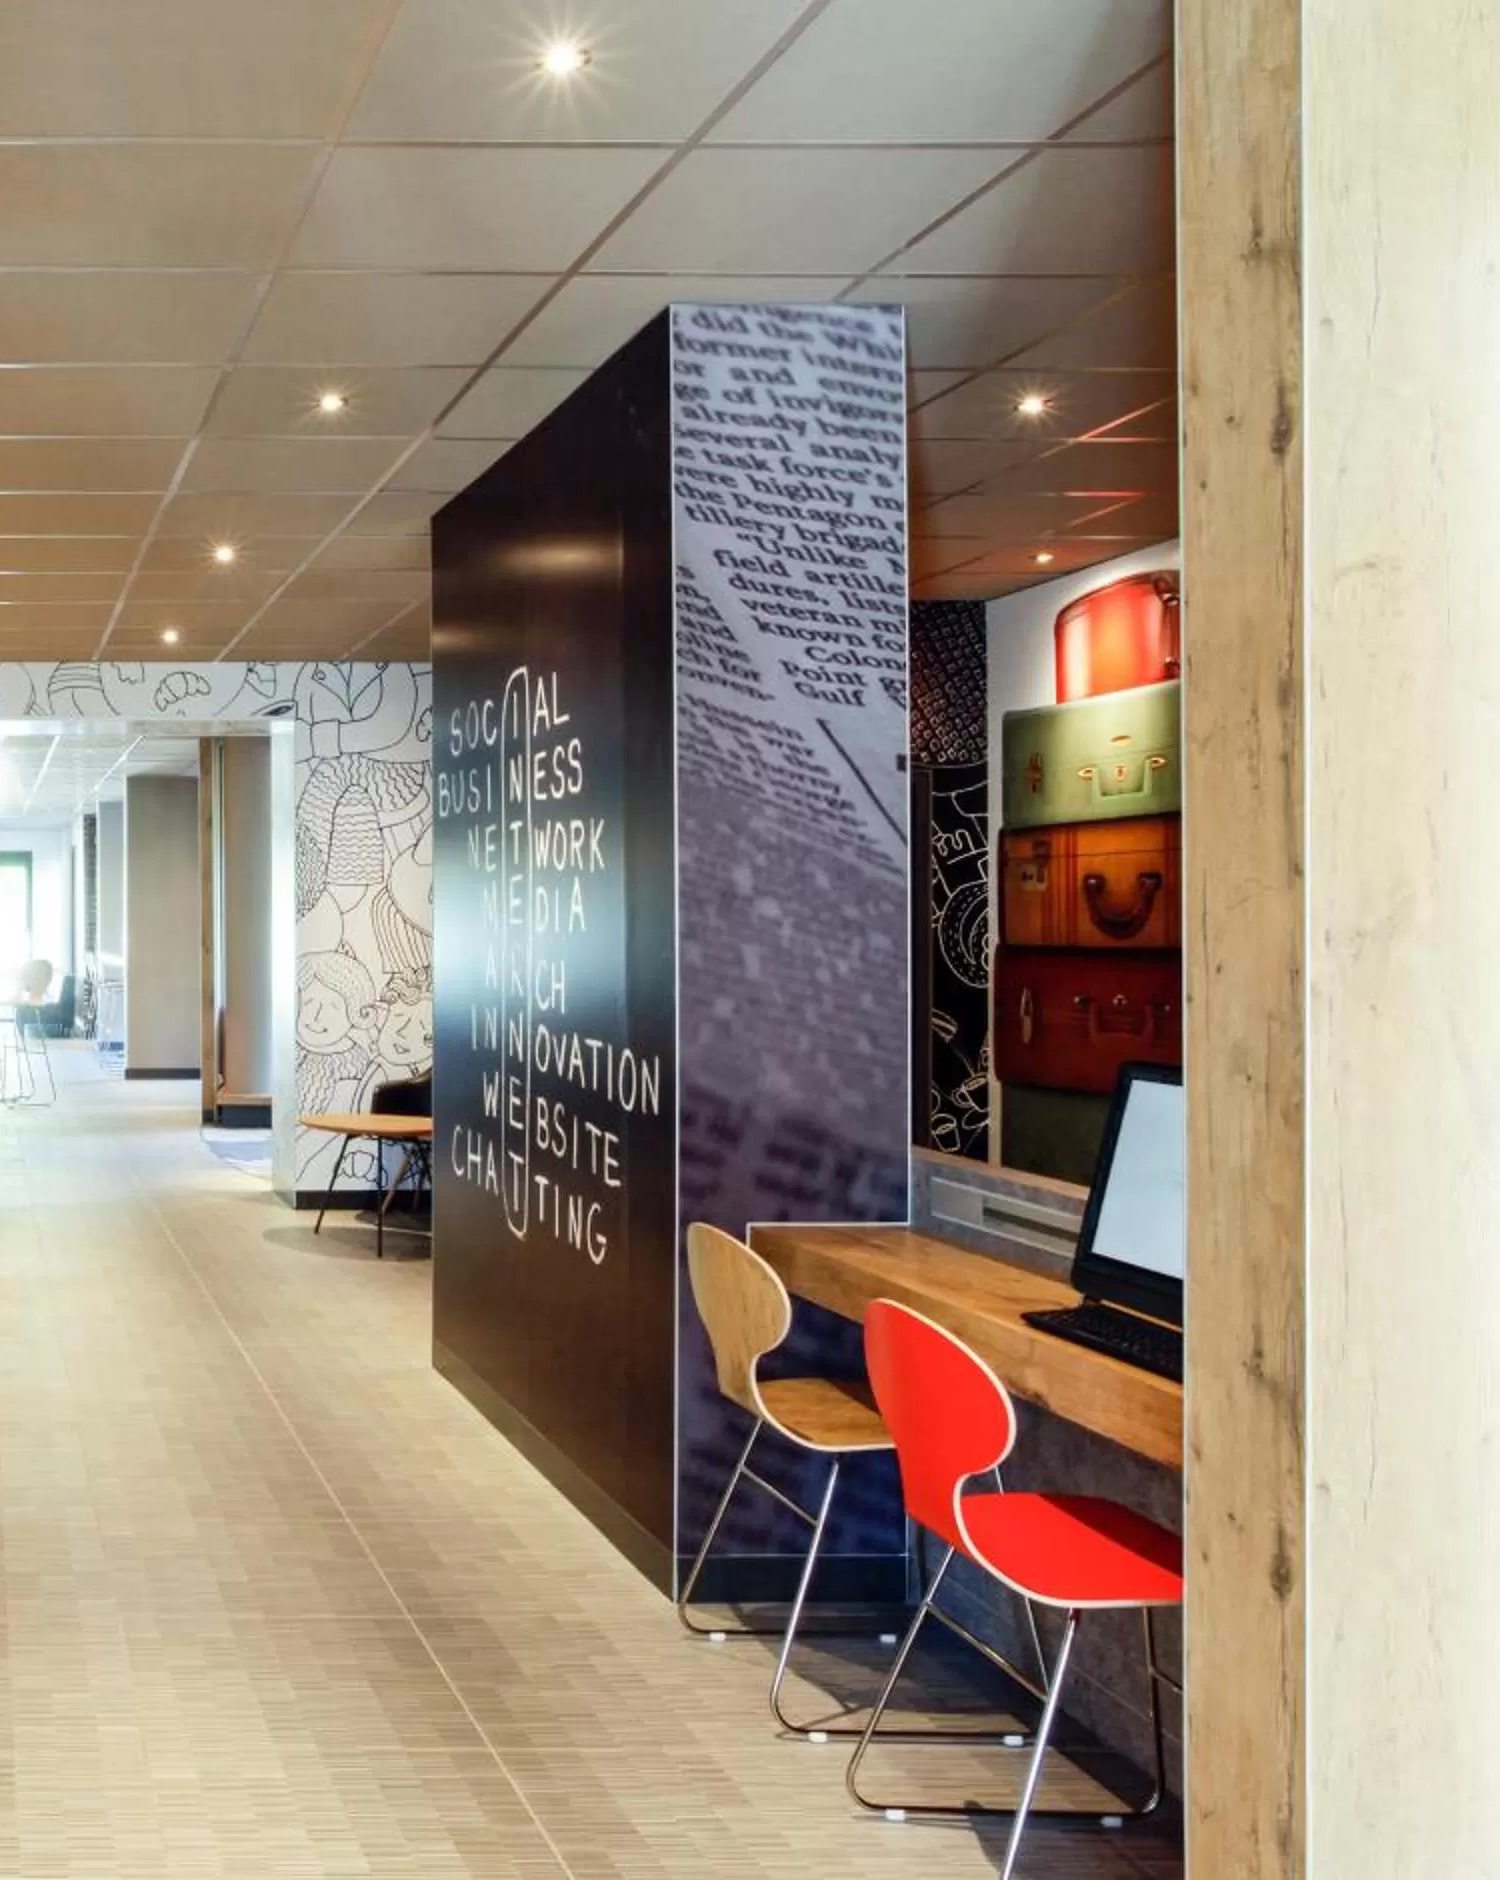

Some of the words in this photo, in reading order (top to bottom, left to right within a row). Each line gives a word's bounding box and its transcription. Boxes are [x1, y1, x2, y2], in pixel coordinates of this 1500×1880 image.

[680, 404, 807, 437] already
[701, 448, 773, 473] task
[745, 472, 855, 508] highly
[684, 503, 786, 541] tillery
[791, 522, 904, 554] brigad
[730, 490, 888, 530] Pentagon
[712, 548, 792, 578] field
[739, 597, 865, 629] veteran
[750, 614, 869, 648] known
[777, 657, 869, 688] Point
[804, 645, 906, 671] Colon
[793, 681, 867, 708] Gulf
[451, 671, 570, 757] SOCIAL
[438, 737, 583, 818] BUSINESS
[467, 817, 605, 873] NETWORK
[483, 874, 587, 934] MEDIA
[471, 1003, 660, 1116] INNOVATION
[483, 1071, 622, 1188] WEBSITE
[451, 1124, 607, 1265] CHATTING
